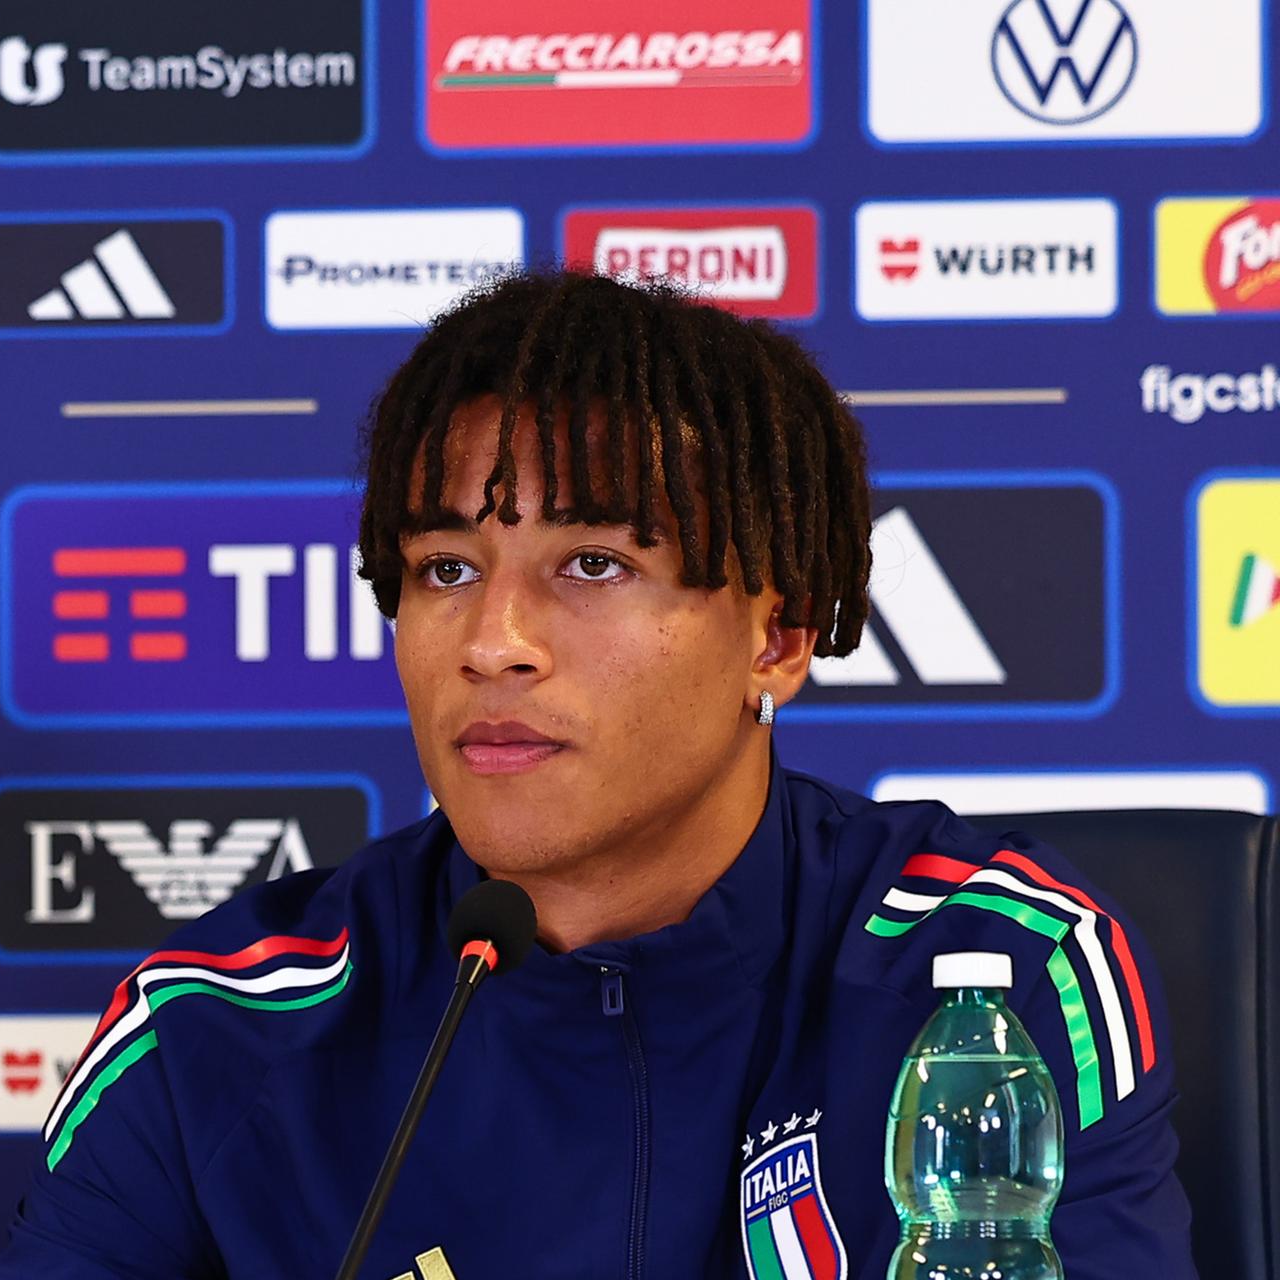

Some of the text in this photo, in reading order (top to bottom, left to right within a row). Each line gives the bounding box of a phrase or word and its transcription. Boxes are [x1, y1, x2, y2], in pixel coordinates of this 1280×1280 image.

[79, 46, 355, 98] TeamSystem
[443, 31, 803, 73] FRECCIAROSSA
[608, 246, 774, 284] PERONI
[745, 1149, 811, 1209] ITALIA
[768, 1191, 789, 1212] FIGC
